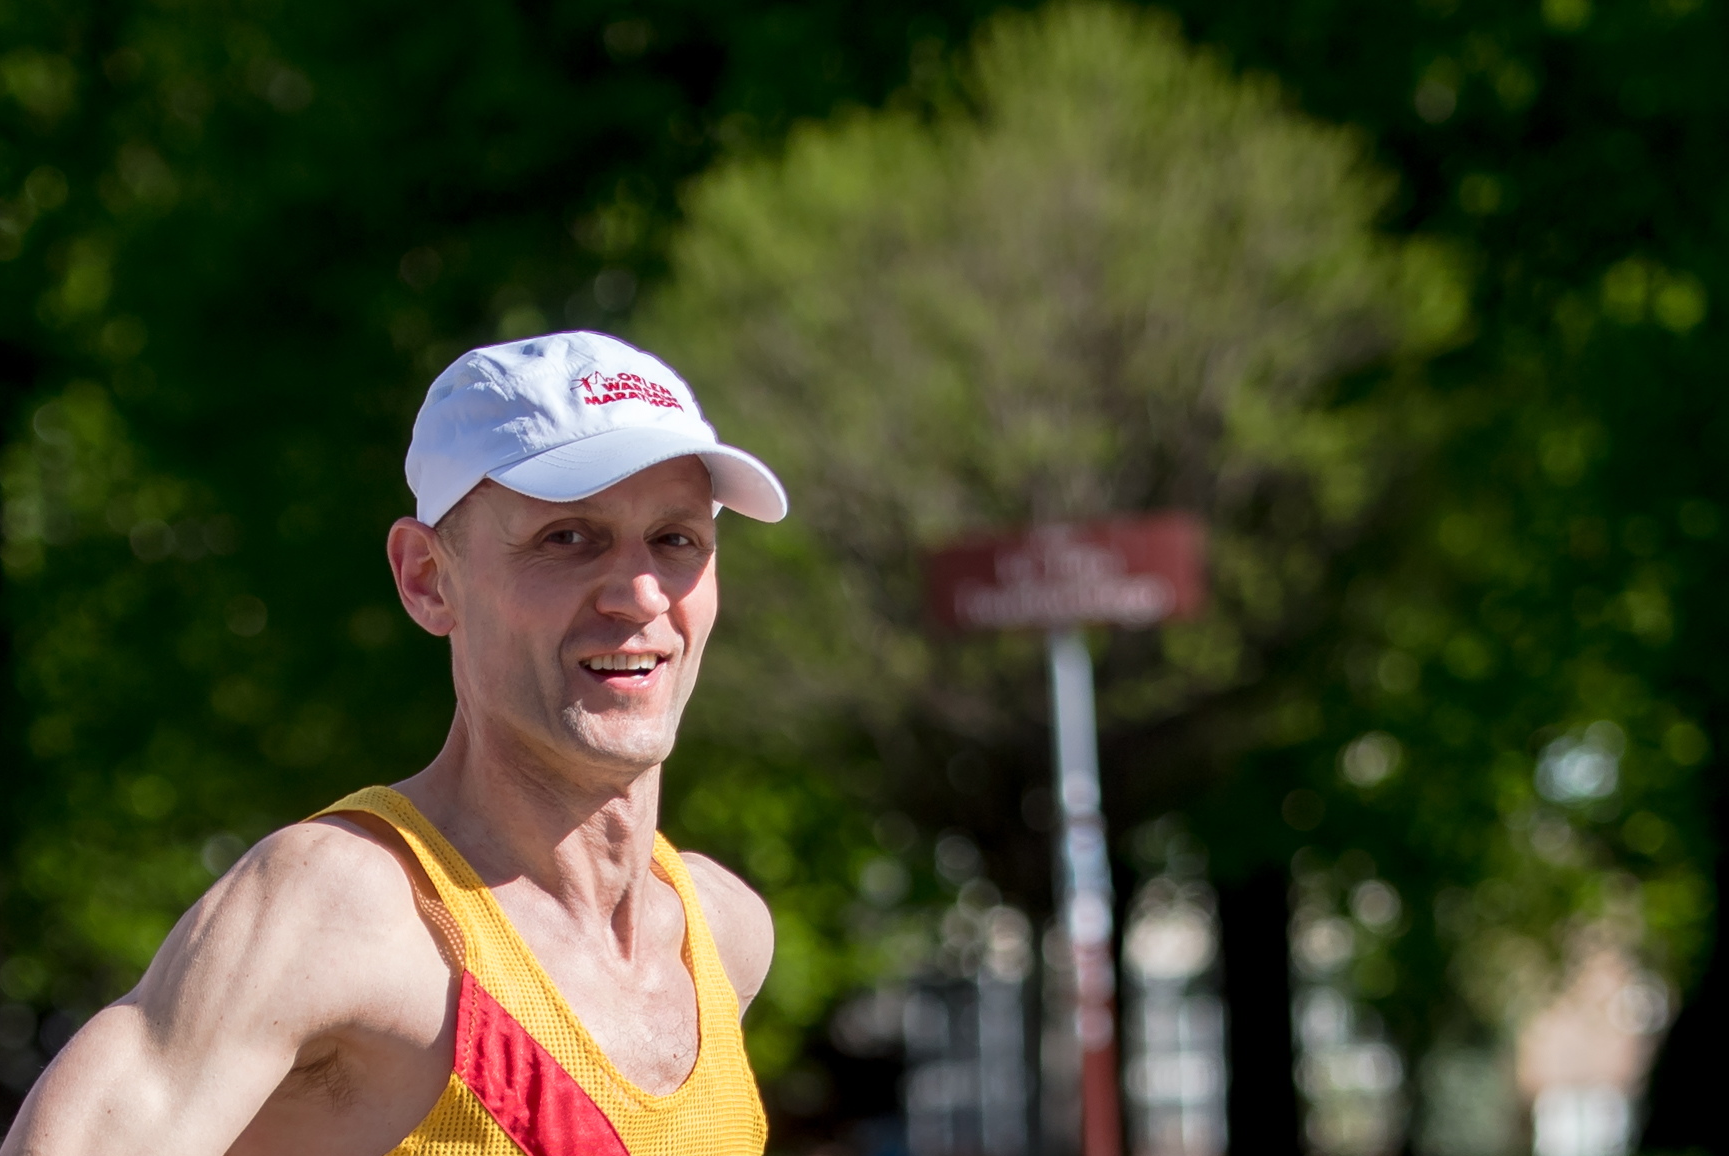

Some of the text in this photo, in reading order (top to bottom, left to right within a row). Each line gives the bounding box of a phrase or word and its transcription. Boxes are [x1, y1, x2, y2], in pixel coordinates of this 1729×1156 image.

[601, 381, 678, 403] WARSAW
[617, 372, 673, 396] ORLEN
[584, 391, 684, 413] MARATHON
